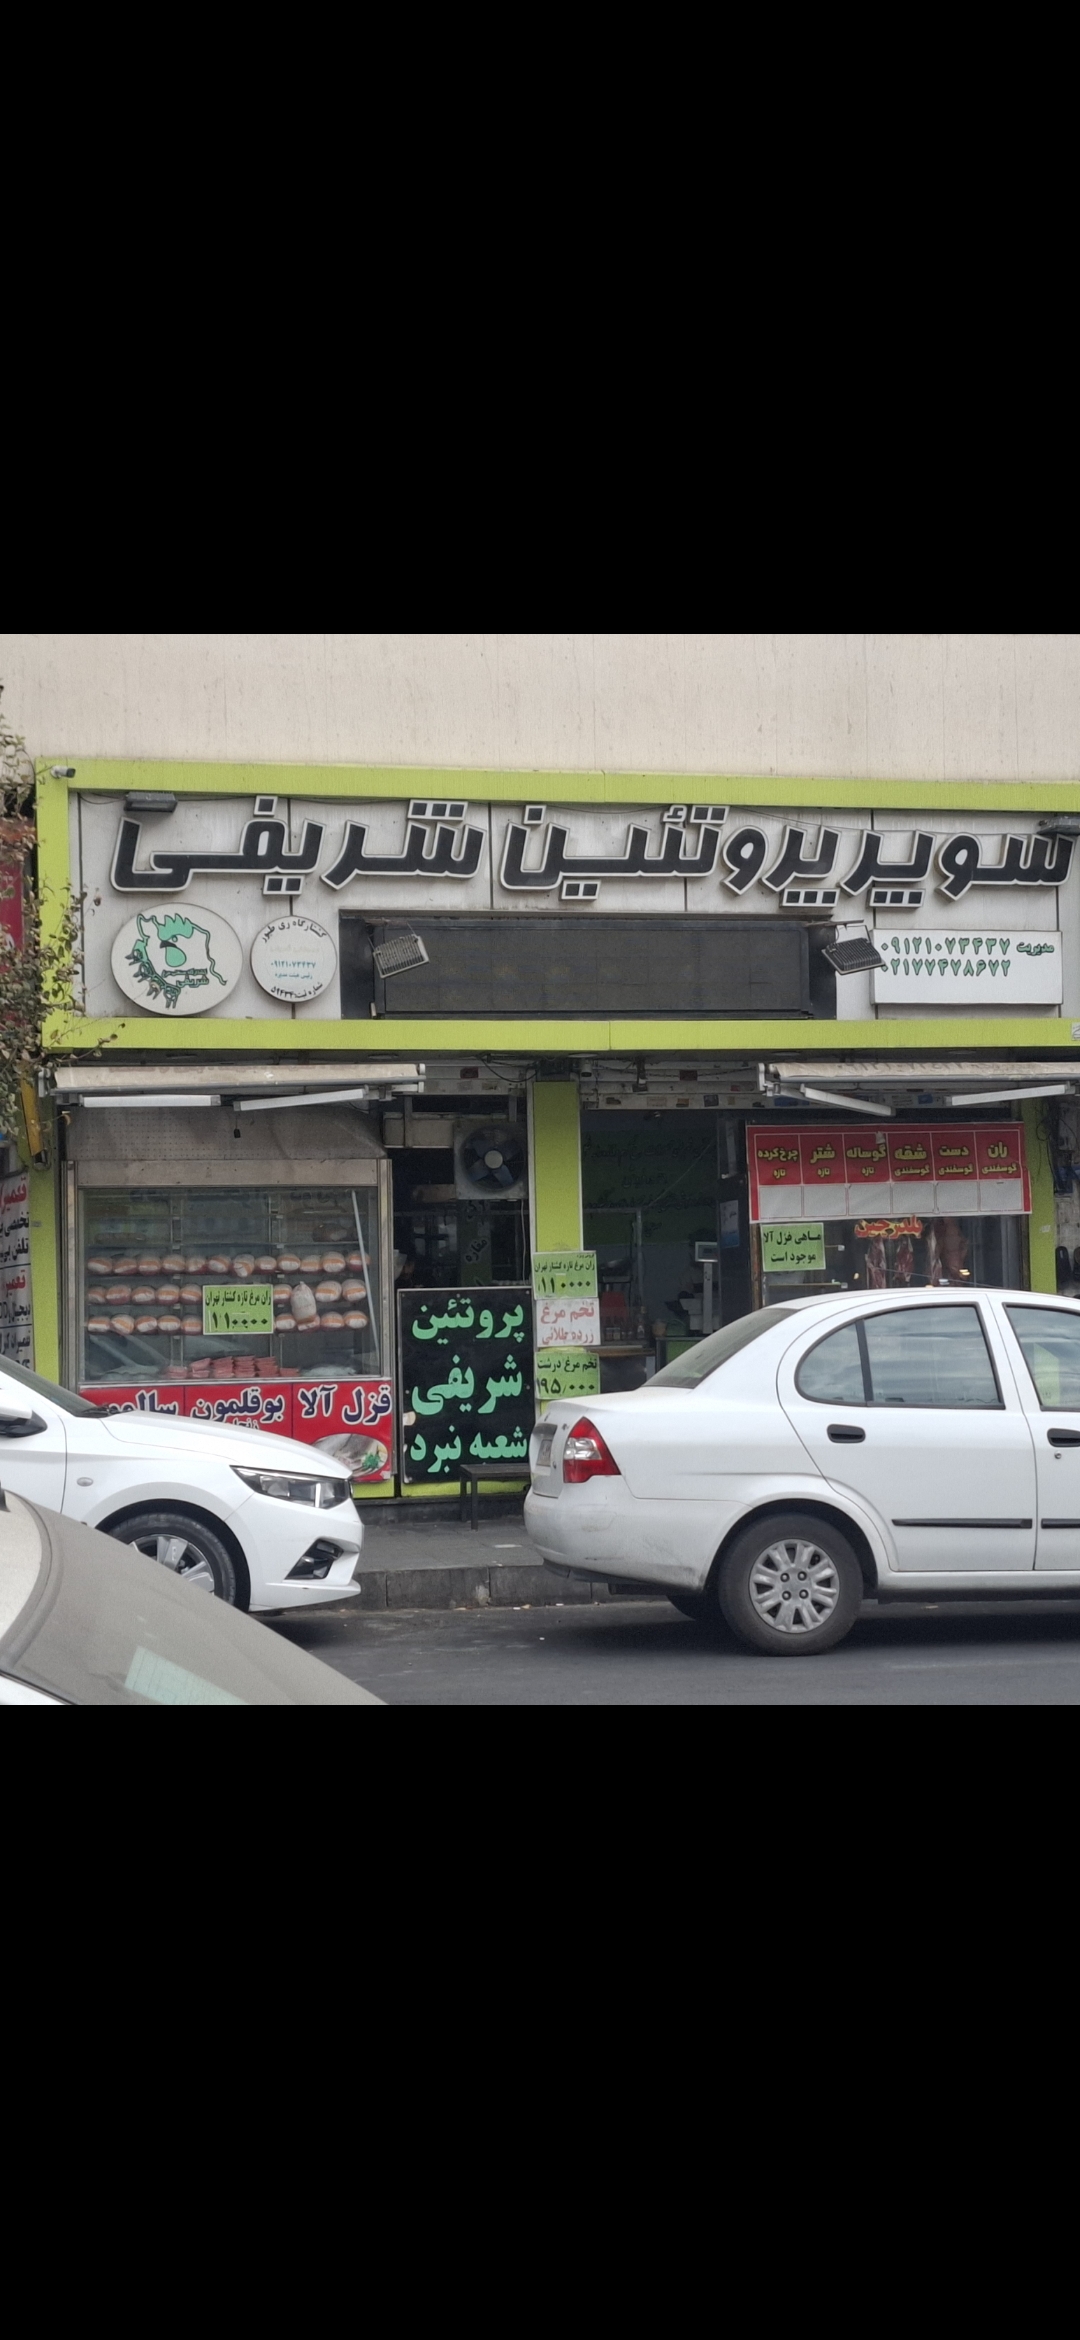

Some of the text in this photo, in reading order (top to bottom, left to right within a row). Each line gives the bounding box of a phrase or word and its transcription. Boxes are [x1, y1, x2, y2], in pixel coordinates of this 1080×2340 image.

[110, 795, 1080, 908] سوپر پروتئین شریفی
[881, 936, 1054, 956] مدیریت ۰۹۱۲۱۰۷۳۴۳۷
[880, 958, 1011, 977] ۰۲۱۷۷۴۷۸۶۷۲
[810, 1144, 836, 1164] شتر
[847, 1144, 886, 1161] گوساله
[894, 1144, 927, 1160] شقه
[940, 1146, 969, 1156] دست
[988, 1142, 1008, 1158] ران
[770, 1252, 816, 1264] موجود است
[248, 1290, 260, 1306] مرغ
[261, 1290, 271, 1306] ران
[412, 1298, 525, 1345] پروتئین
[540, 1302, 594, 1324] تخم مرغ
[538, 1356, 597, 1373] تخم مرغ درشت
[411, 1354, 522, 1416] شریفی
[190, 1386, 284, 1424] بوقلمون
[298, 1384, 392, 1426] قزل آلا
[410, 1425, 462, 1473] نبرد
[470, 1426, 528, 1459] شعبه
